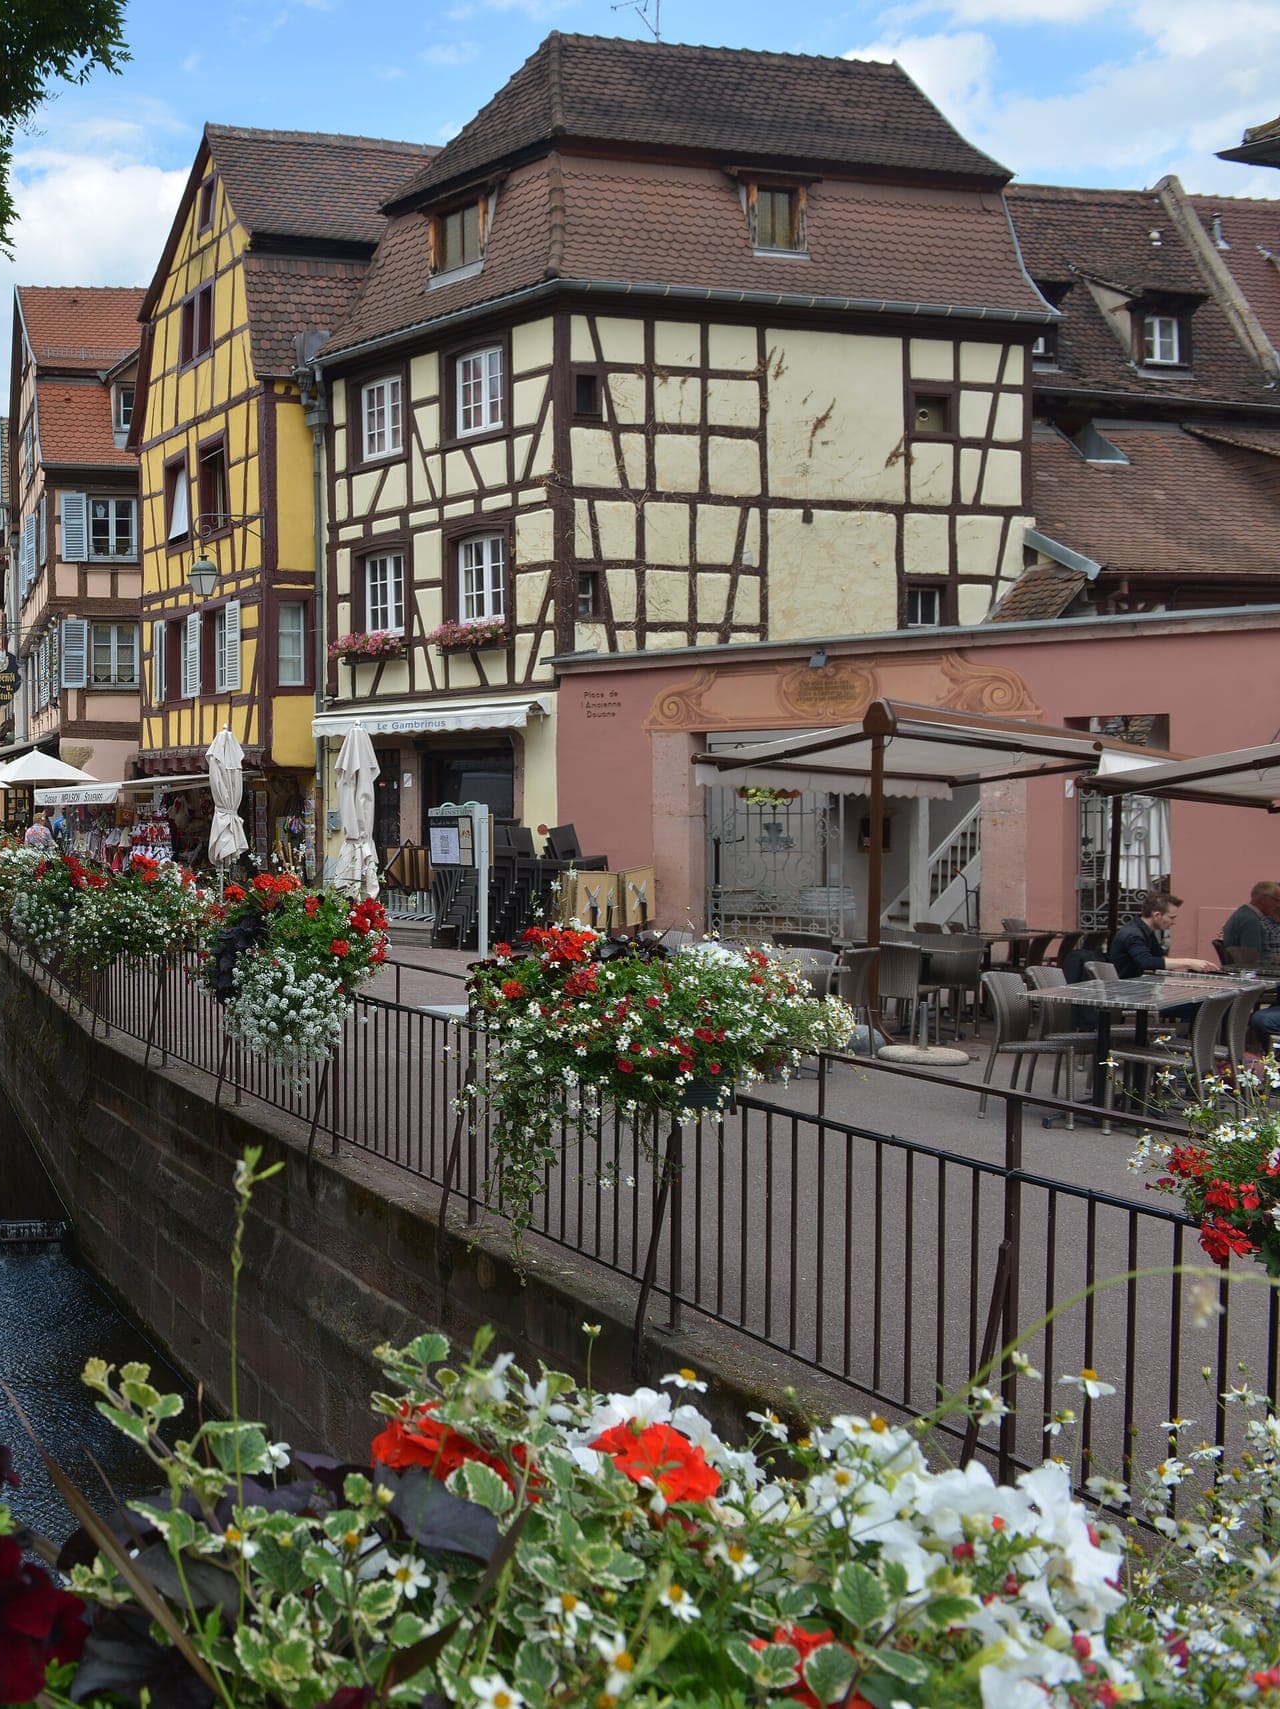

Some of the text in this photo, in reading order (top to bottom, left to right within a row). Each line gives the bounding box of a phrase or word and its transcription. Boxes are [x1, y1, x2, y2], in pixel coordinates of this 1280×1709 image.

[584, 690, 618, 699] Place de
[587, 710, 616, 719] Douane
[377, 719, 447, 731] Le Gambrinus
